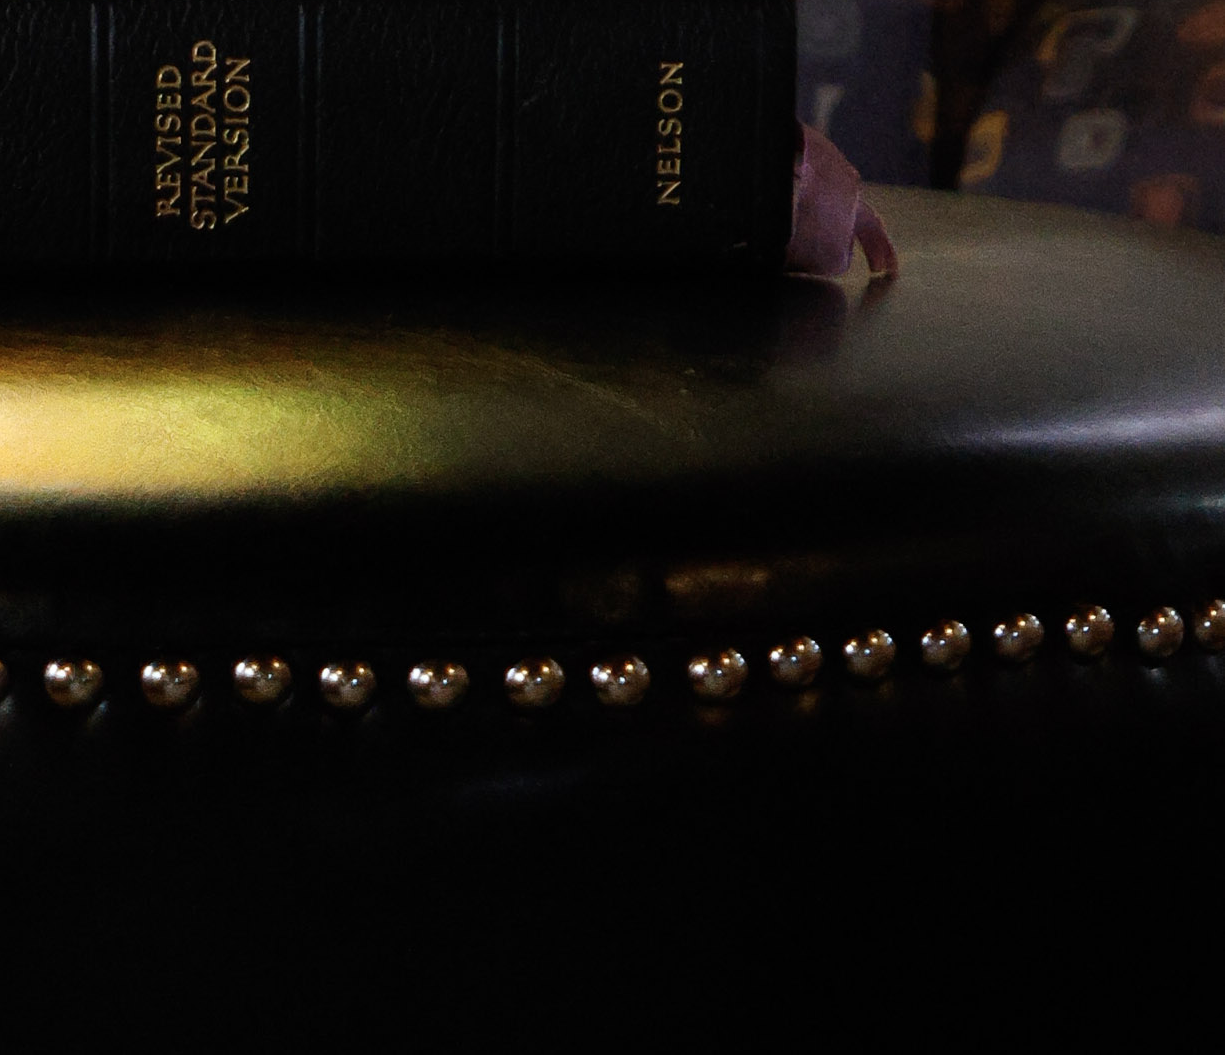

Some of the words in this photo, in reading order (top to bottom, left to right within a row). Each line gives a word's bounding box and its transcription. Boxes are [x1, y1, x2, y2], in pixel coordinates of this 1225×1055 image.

[156, 64, 182, 218] REVISED
[190, 40, 218, 231] STANDARD
[223, 57, 251, 226] VERSION
[657, 61, 685, 206] NELSON
